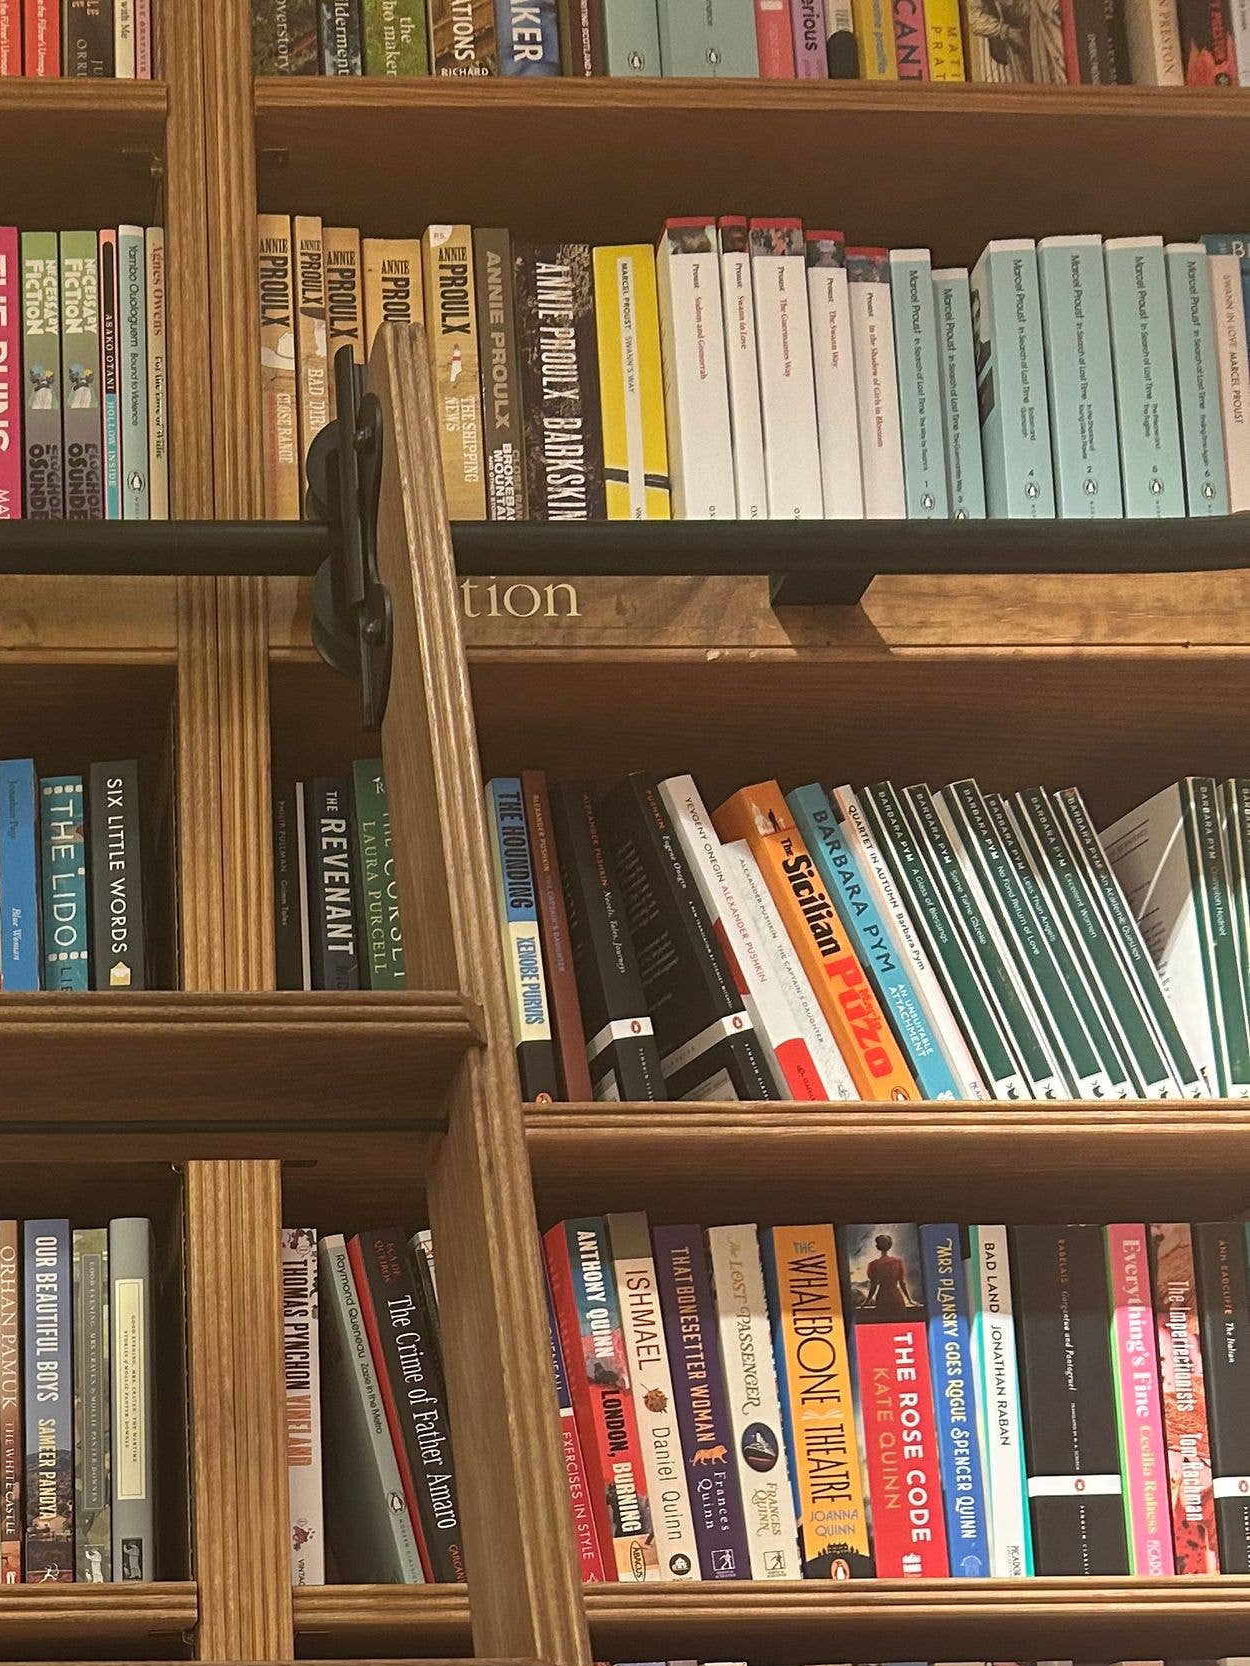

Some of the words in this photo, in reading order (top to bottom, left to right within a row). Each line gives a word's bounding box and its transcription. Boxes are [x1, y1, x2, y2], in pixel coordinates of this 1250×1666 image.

[441, 66, 489, 78] RICHARD
[438, 247, 467, 261] ANNIE
[439, 264, 470, 334] PROULX
[536, 262, 573, 319] ANNIE
[540, 327, 579, 400] PROULX
[461, 576, 582, 617] tion
[107, 779, 123, 807] SIX
[499, 792, 522, 821] THE
[51, 799, 74, 861] THE
[108, 815, 124, 871] LITTLE
[502, 827, 533, 908] HOUNDING
[813, 808, 869, 917] BARBARA
[863, 924, 896, 974] PYM
[52, 873, 77, 946] LIDO
[110, 878, 127, 953] WORDS
[985, 1243, 995, 1270] BAD
[625, 1270, 661, 1371] ISHMAEL
[987, 1277, 999, 1314] LAND
[894, 1332, 916, 1381] THE
[992, 1327, 1006, 1396] JONATHAN
[899, 1393, 923, 1459] ROSE
[997, 1402, 1011, 1446] RABAN
[653, 1428, 677, 1482] Daniel
[661, 1491, 682, 1541] Quinn
[906, 1470, 931, 1543] CODE
